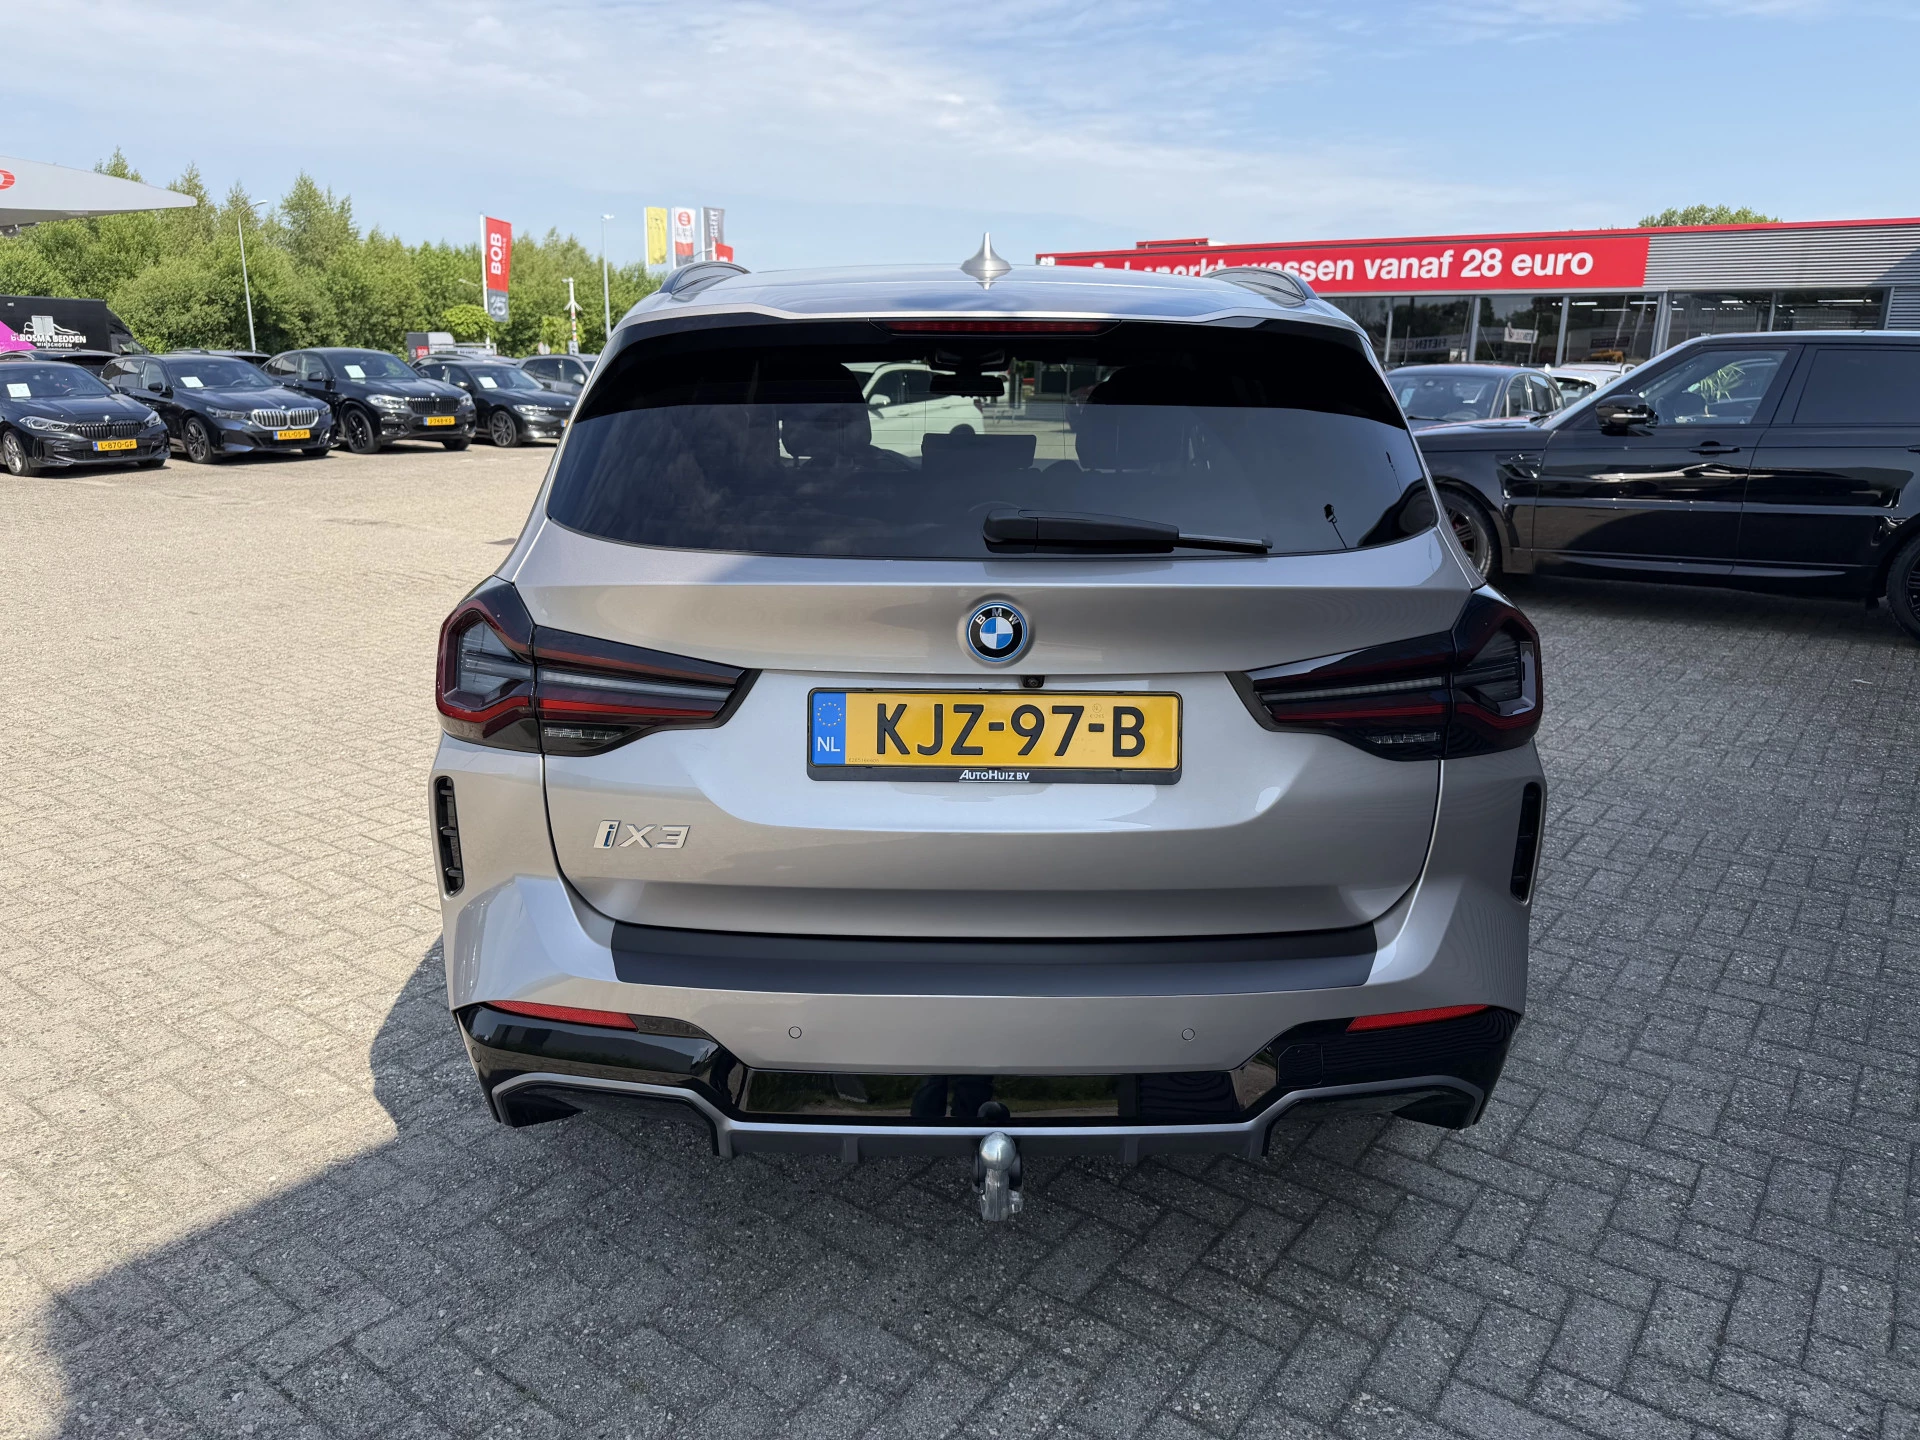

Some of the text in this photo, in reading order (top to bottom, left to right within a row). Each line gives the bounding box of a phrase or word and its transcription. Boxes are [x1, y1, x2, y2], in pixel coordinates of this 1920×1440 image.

[490, 232, 503, 276] BOB
[1242, 257, 1354, 282] ssen
[1364, 249, 1455, 280] vanaf
[1460, 248, 1502, 278] 28
[1511, 251, 1594, 276] euro
[53, 335, 87, 343] BEDDEN
[975, 608, 1020, 625] BMW
[876, 703, 1146, 757] KJZ-97-B
[817, 736, 841, 752] NL
[1016, 772, 1030, 780] BV
[593, 819, 691, 848] iX3
